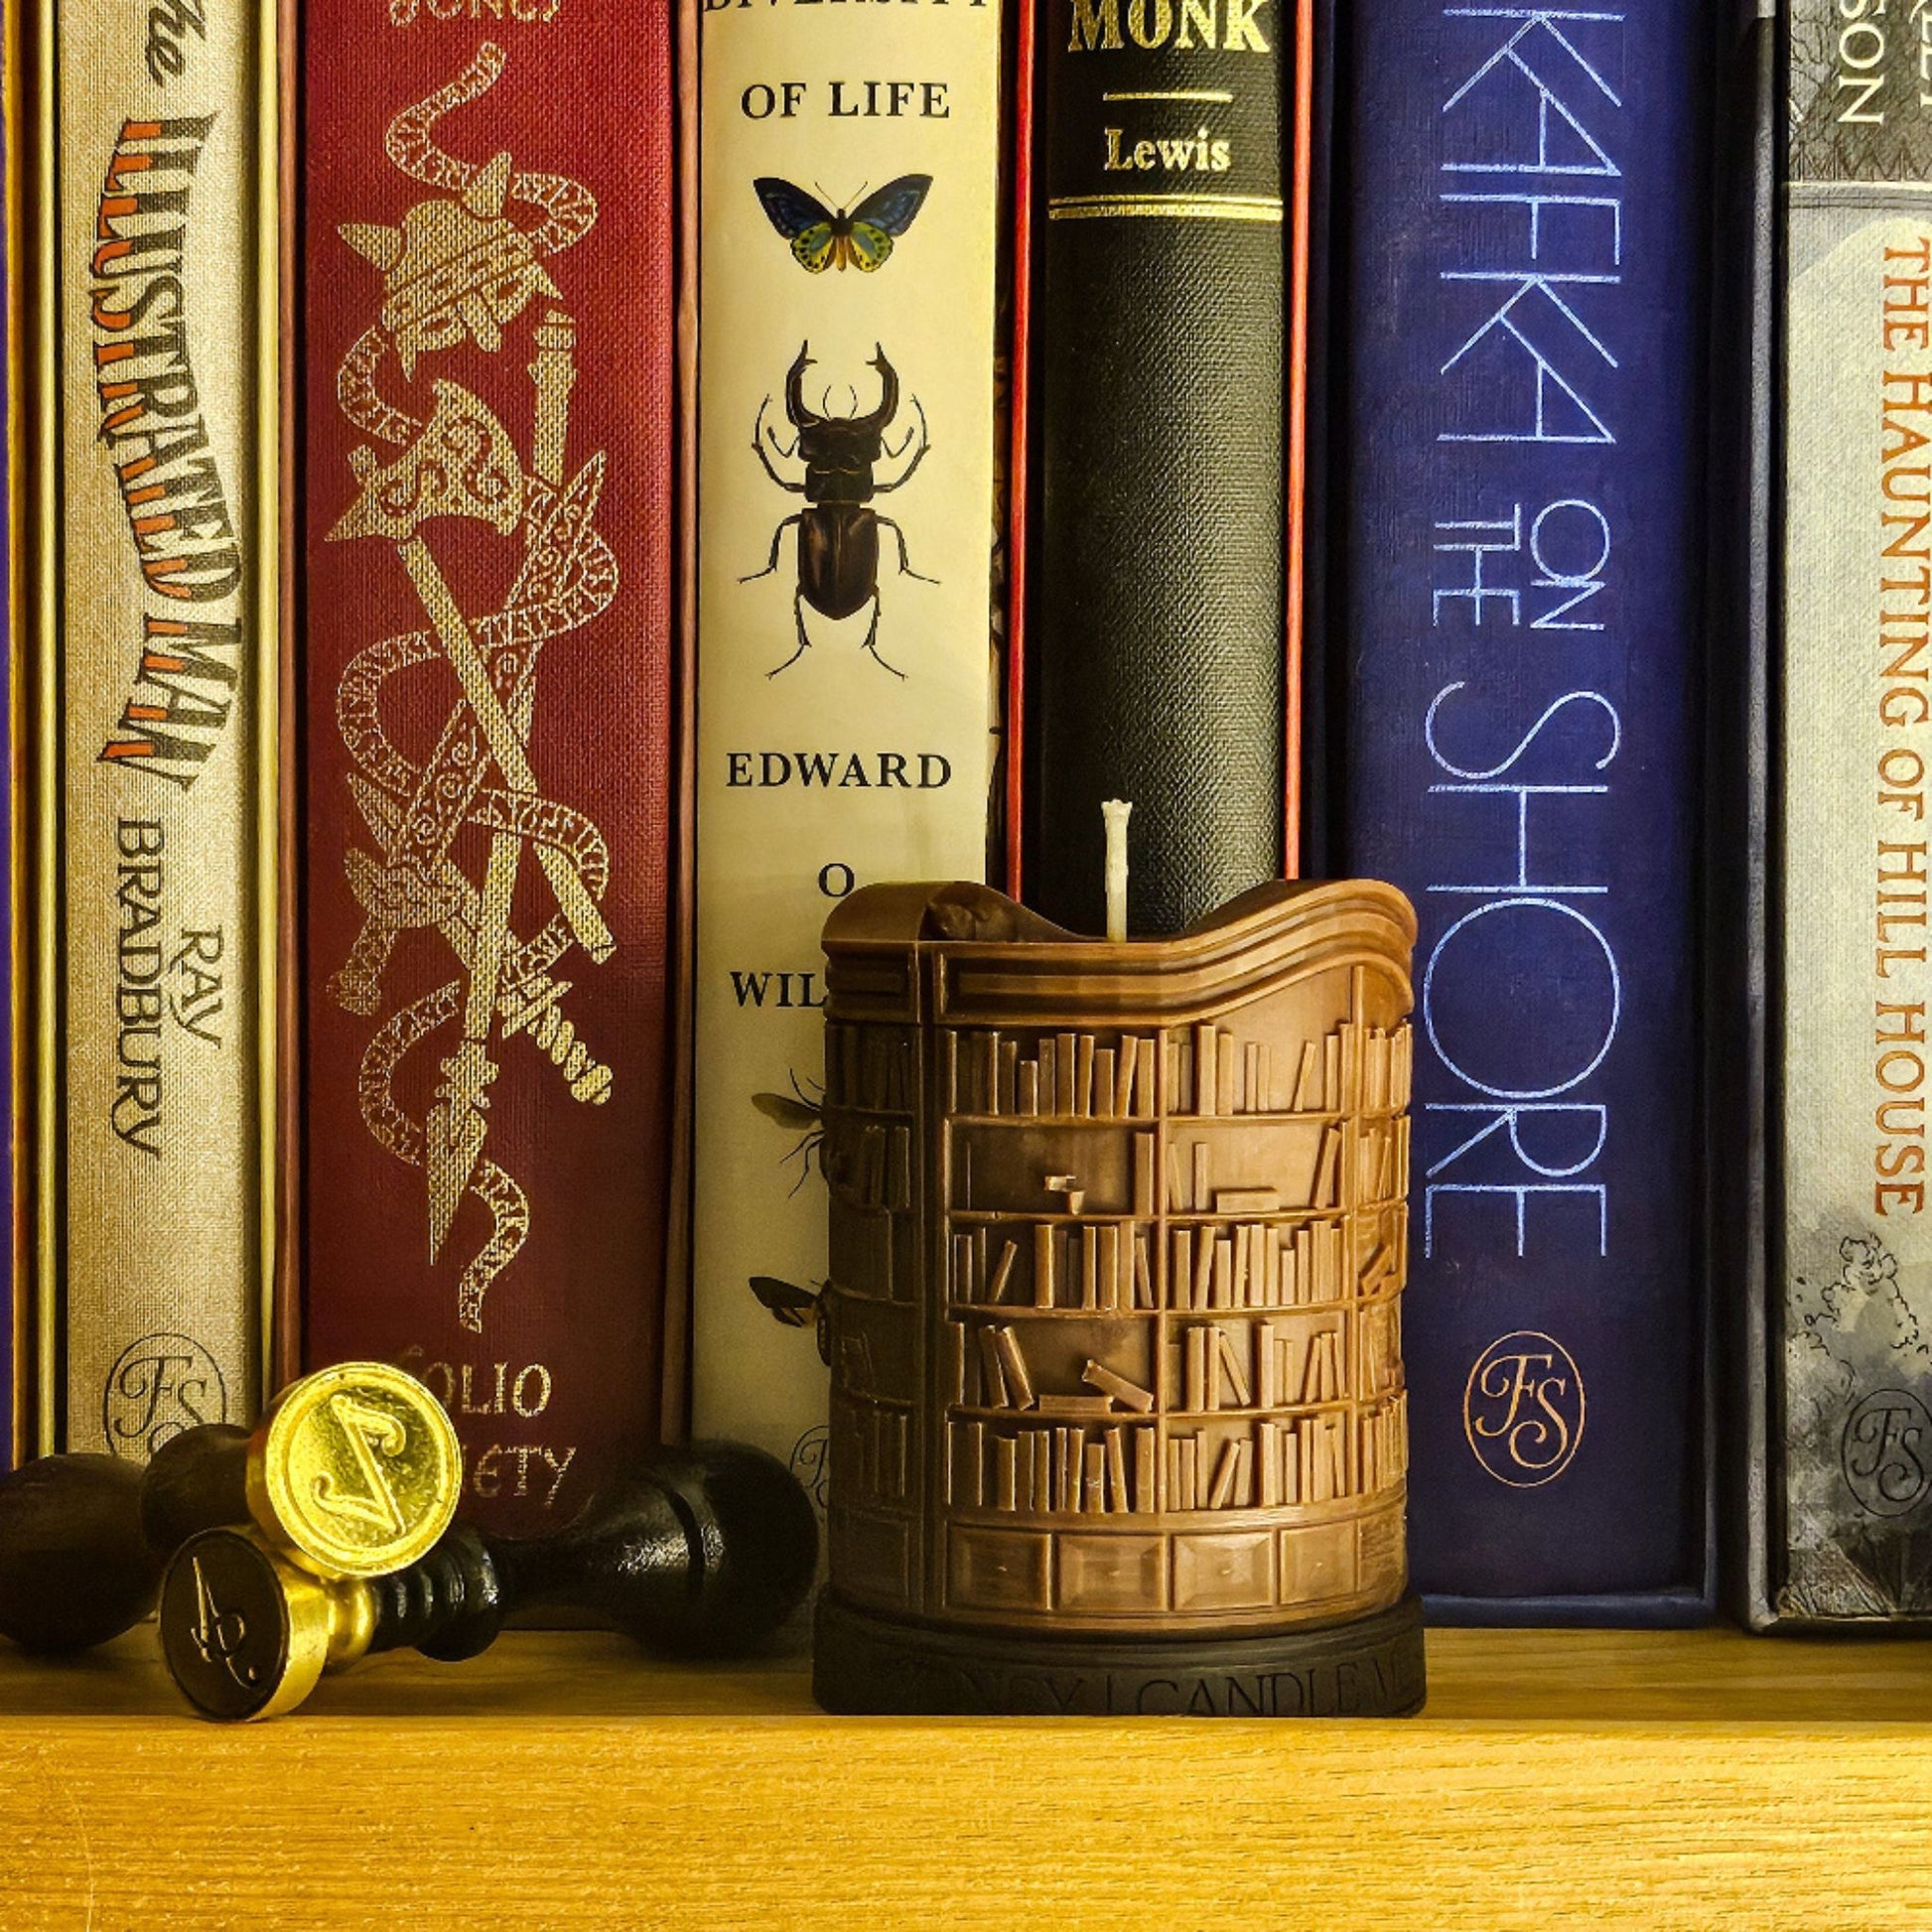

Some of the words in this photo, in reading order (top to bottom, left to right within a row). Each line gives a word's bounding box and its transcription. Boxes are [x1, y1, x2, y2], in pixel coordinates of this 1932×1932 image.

[145, 0, 207, 89] he
[1068, 0, 1271, 53] MONK
[741, 81, 807, 118] OF
[828, 80, 950, 118] LIFE
[1104, 126, 1231, 171] Lewis
[1437, 7, 1624, 444] KAFKA
[88, 109, 241, 603] ILLUSTRATED
[1882, 236, 1932, 352] THE
[1433, 502, 1521, 626] THE
[1530, 498, 1609, 630] ON
[1878, 369, 1932, 728] HAUNTING
[96, 612, 241, 792] MAN
[726, 752, 952, 789] EDWARD
[1875, 749, 1926, 822] OF
[818, 863, 855, 897] O
[1874, 839, 1928, 979] HILL
[110, 817, 164, 1160] BRADBURY
[180, 924, 224, 1049] RAY
[1424, 681, 1621, 1259] SHORE
[1873, 1000, 1927, 1217] HOUSE
[407, 1347, 552, 1418] OLIO
